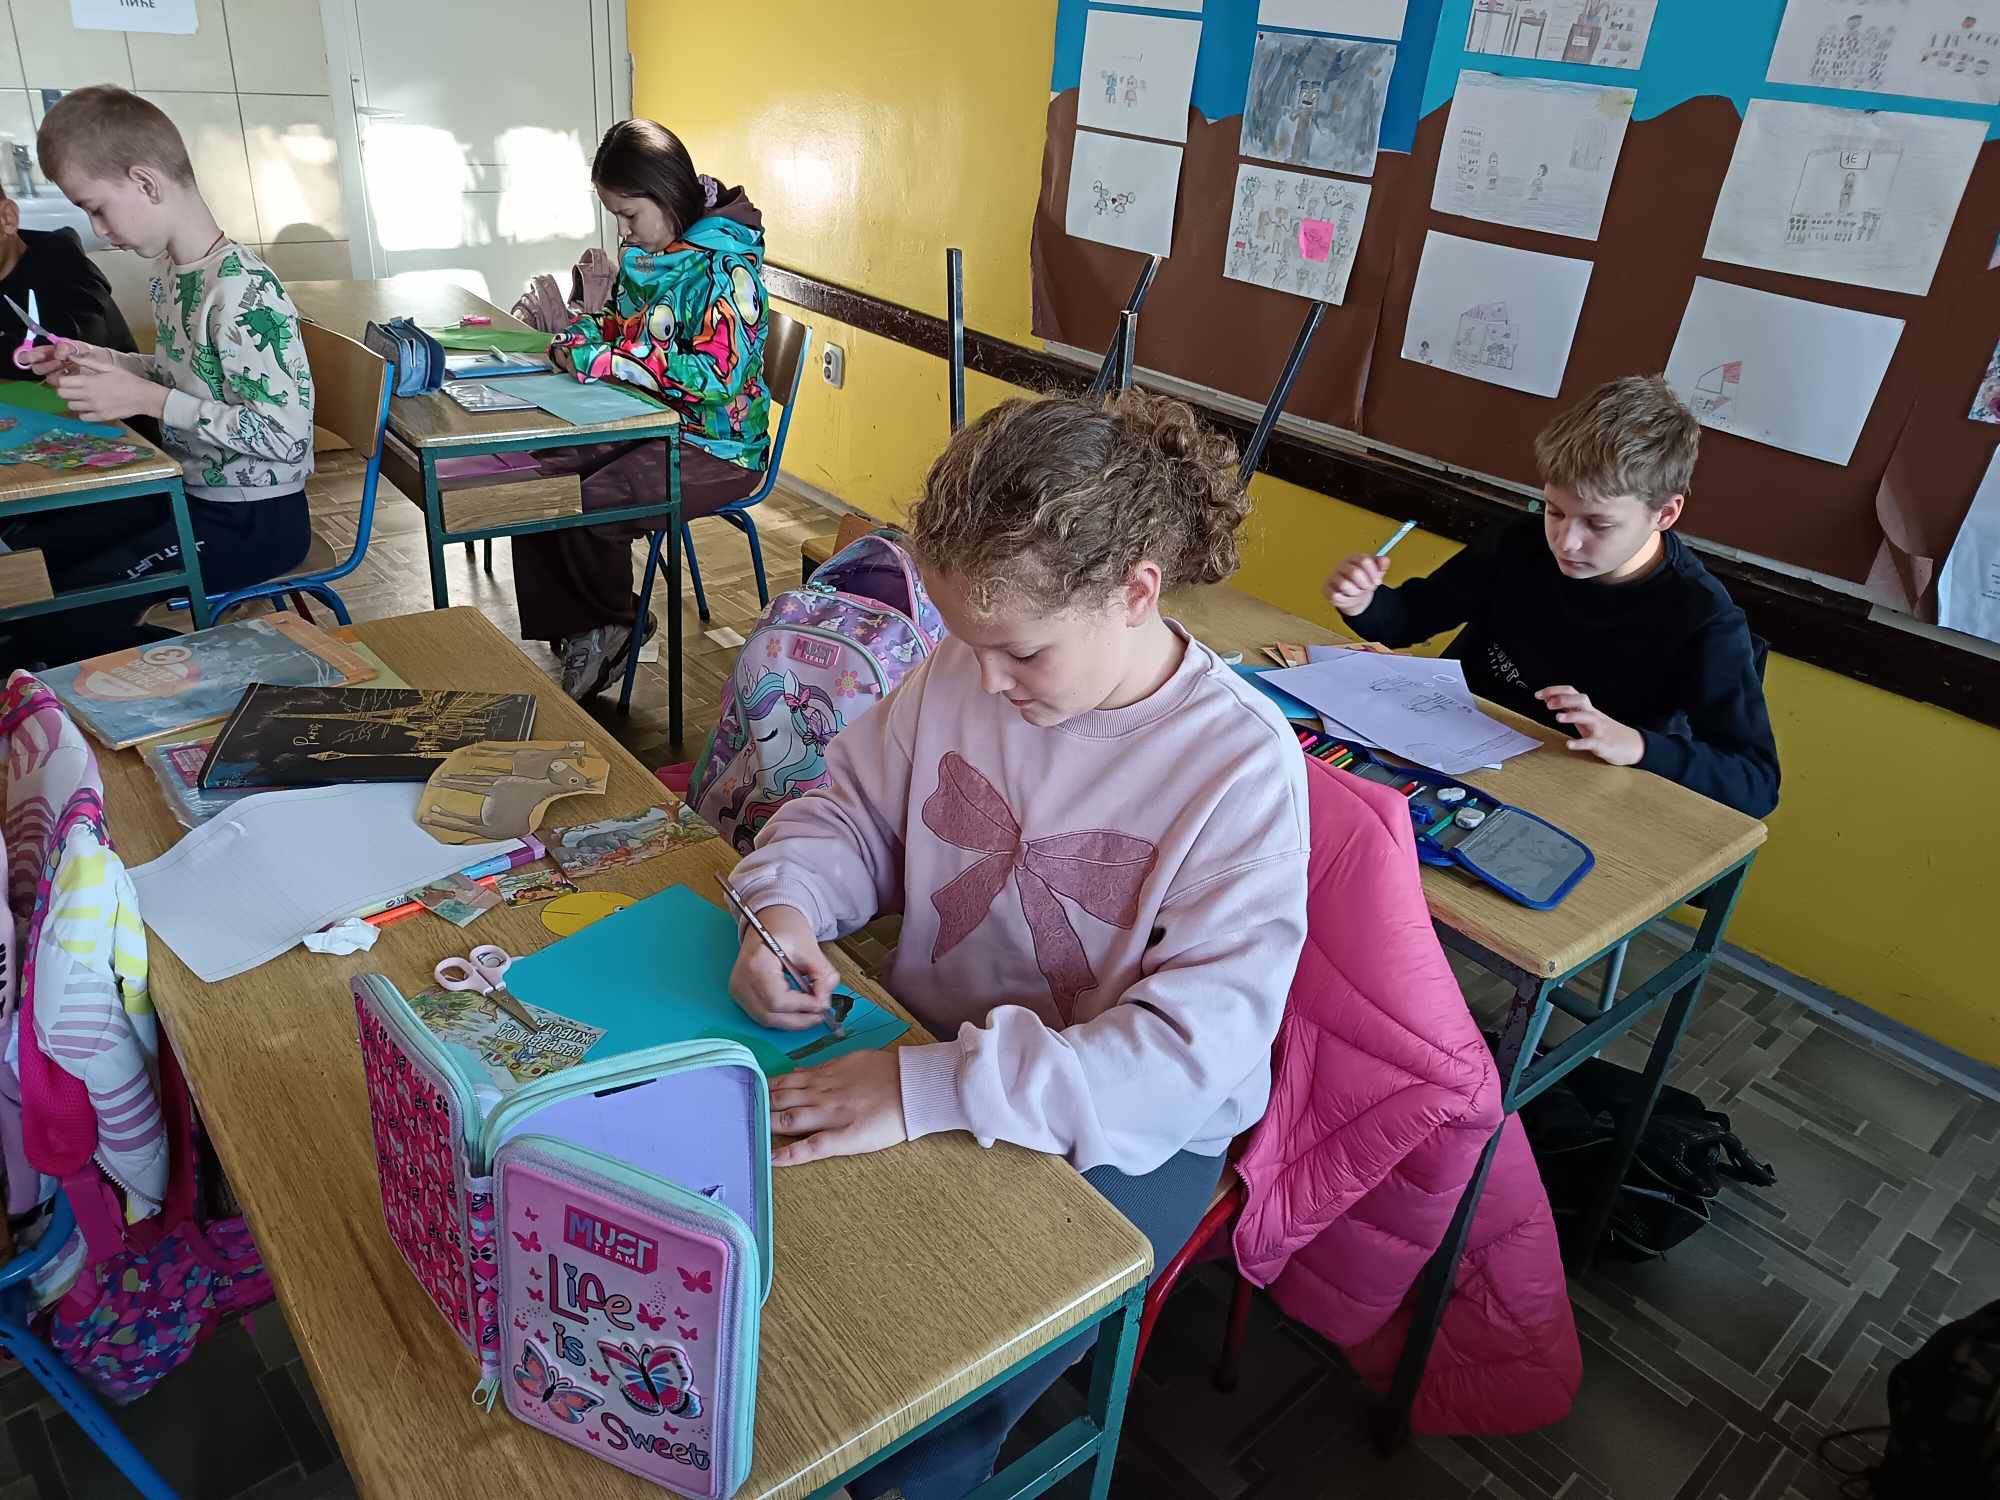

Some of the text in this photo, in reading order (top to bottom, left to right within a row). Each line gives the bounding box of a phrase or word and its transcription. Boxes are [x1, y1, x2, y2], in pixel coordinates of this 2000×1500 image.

[495, 1022, 584, 1058] СВЕ ВРВИ ОД
[568, 1211, 655, 1270] MUST
[593, 1242, 636, 1267] TEAM
[548, 1253, 636, 1332] Life
[553, 1321, 587, 1367] is
[600, 1411, 711, 1472] Sweet
